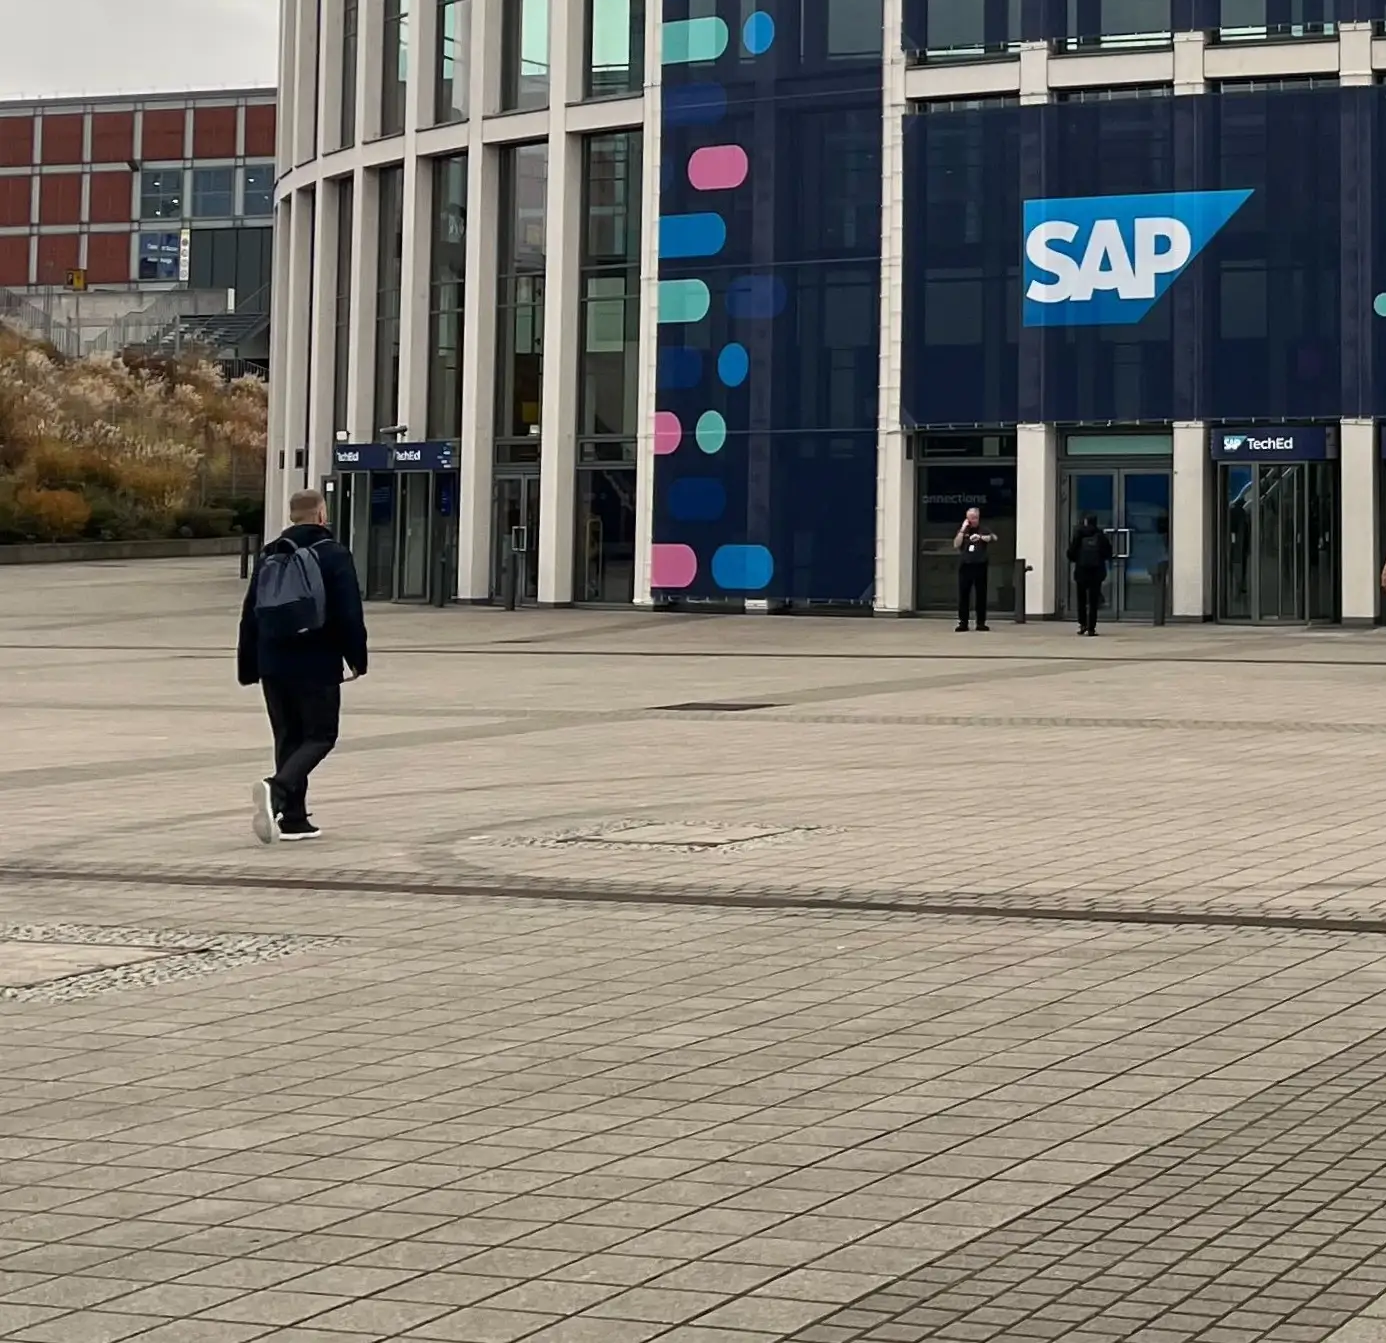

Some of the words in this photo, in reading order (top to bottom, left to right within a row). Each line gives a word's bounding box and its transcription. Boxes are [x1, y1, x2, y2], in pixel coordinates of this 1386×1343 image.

[1025, 216, 1192, 303] SAP
[1223, 436, 1243, 450] SAP
[1247, 437, 1293, 450] TechEd
